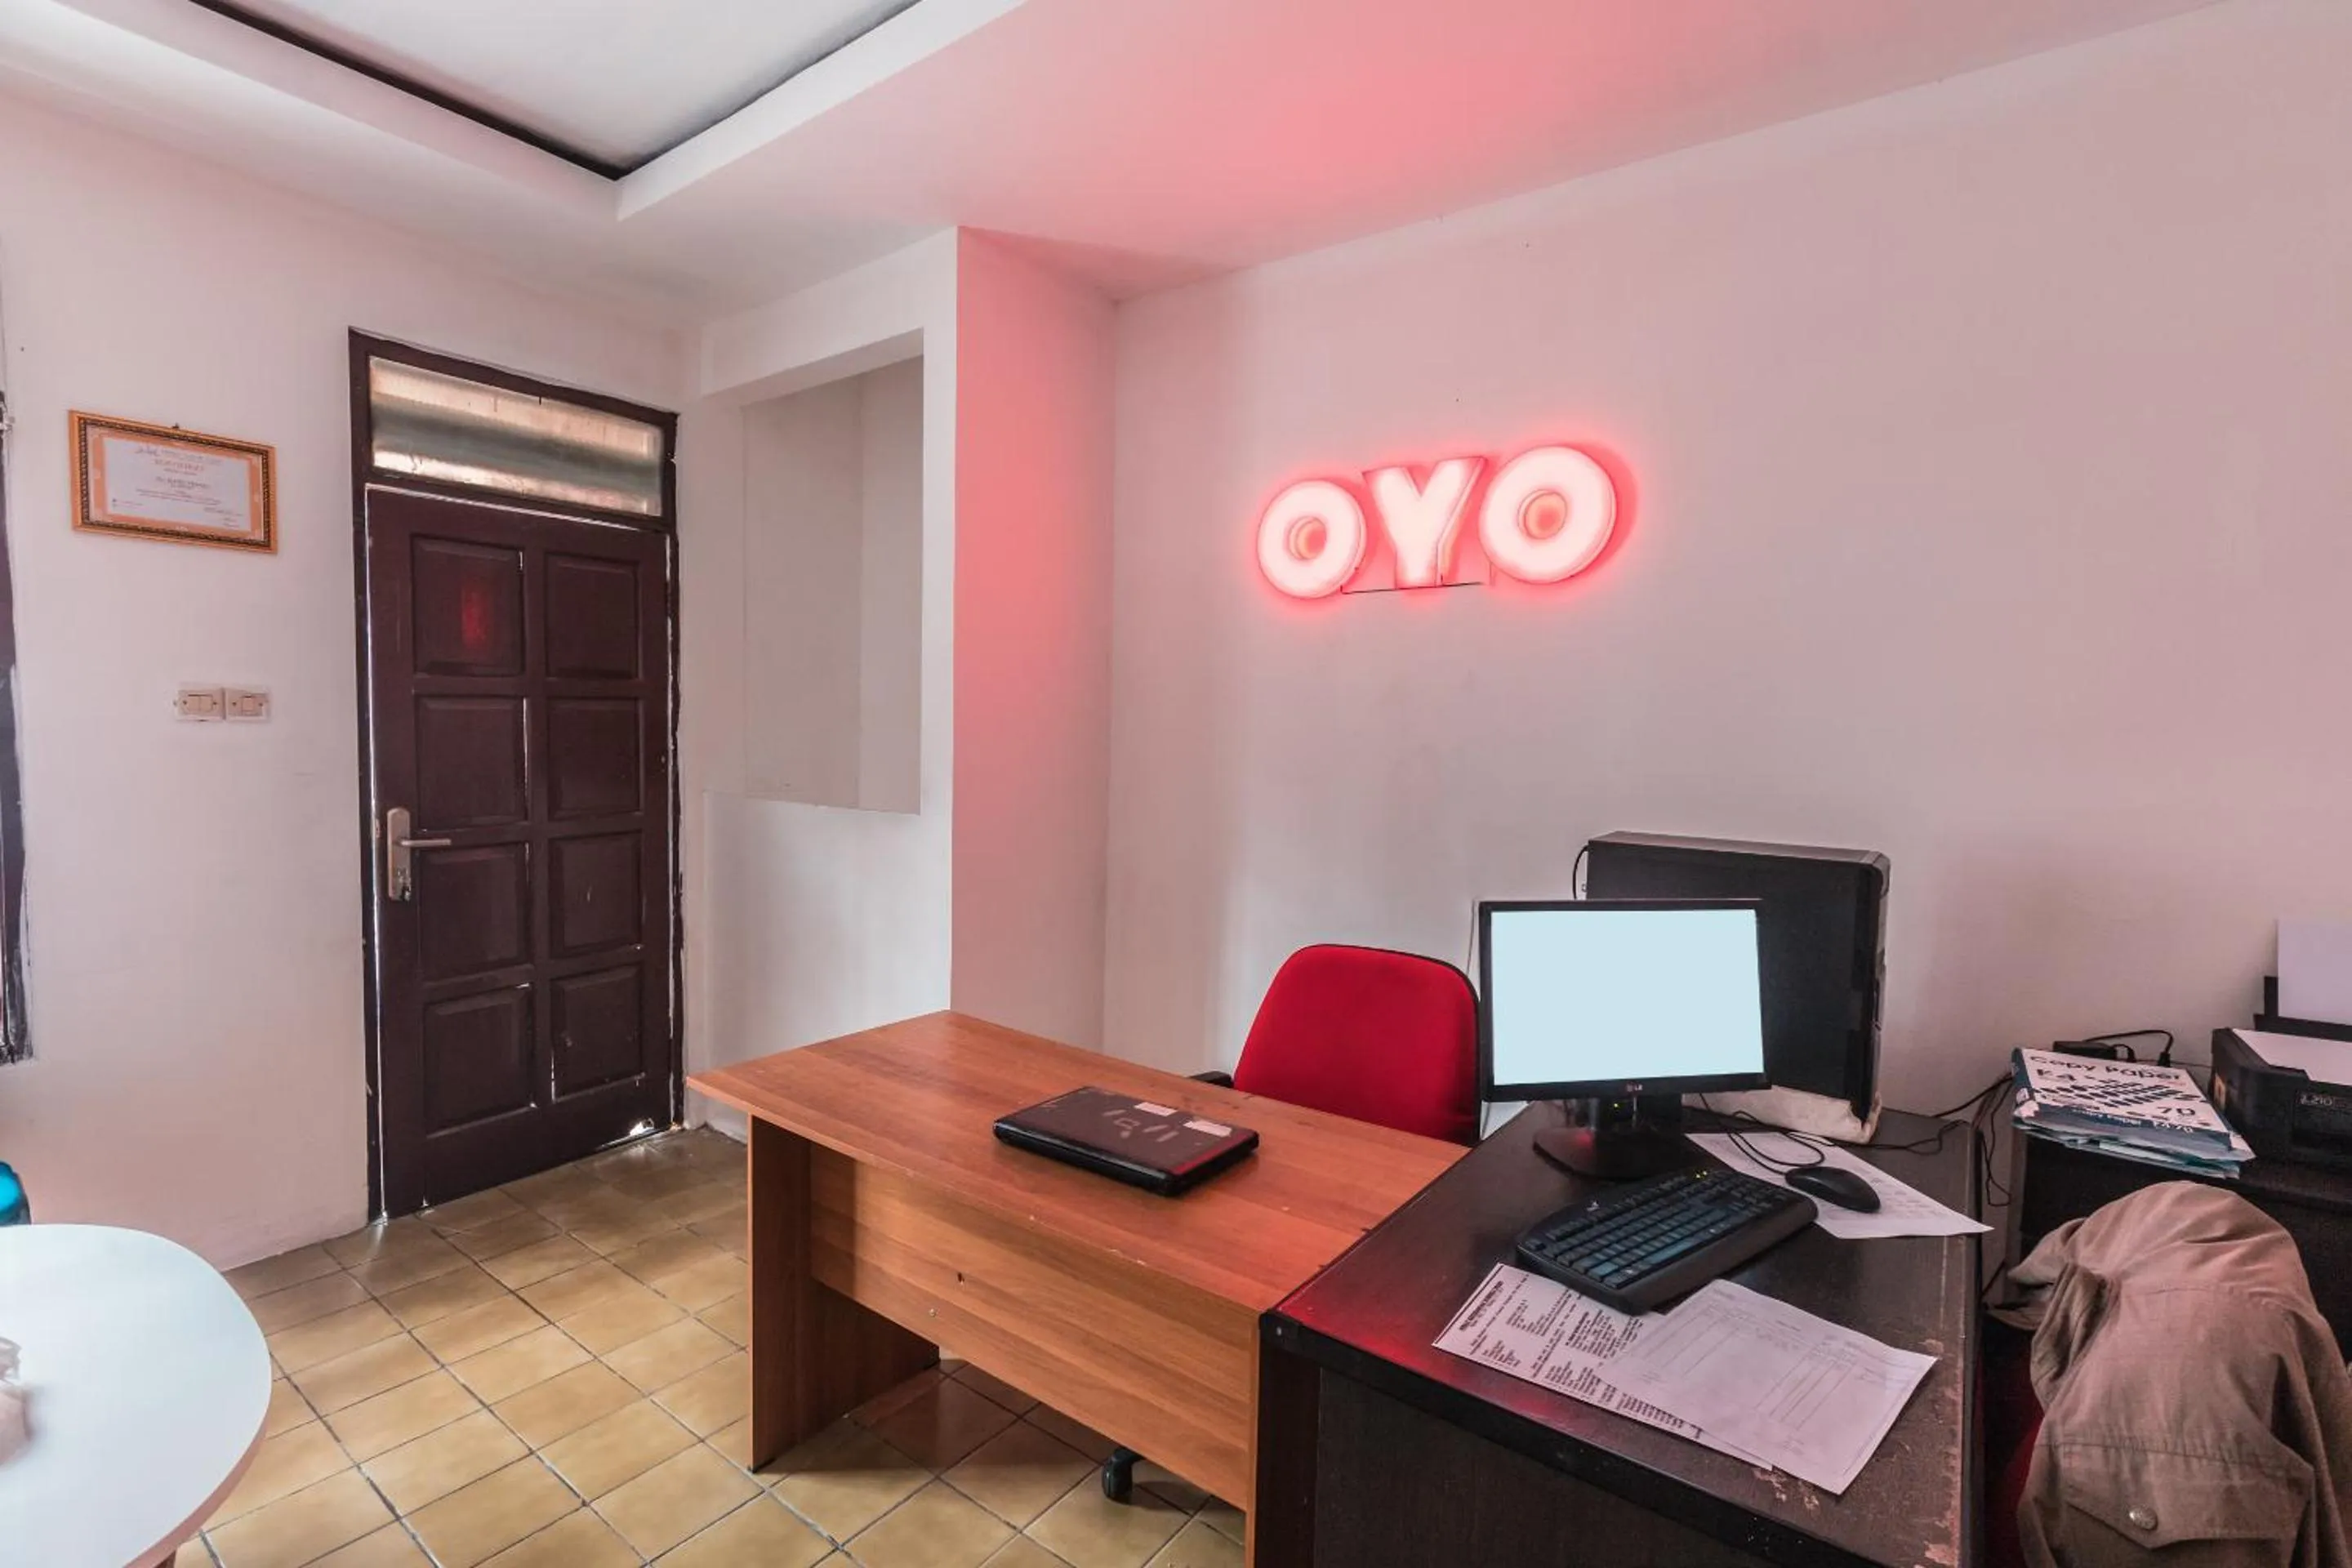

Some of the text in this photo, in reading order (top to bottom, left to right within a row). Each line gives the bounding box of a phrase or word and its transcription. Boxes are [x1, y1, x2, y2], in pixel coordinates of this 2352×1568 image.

[1257, 445, 1617, 599] OYO
[2029, 1056, 2180, 1080] Copy Paper
